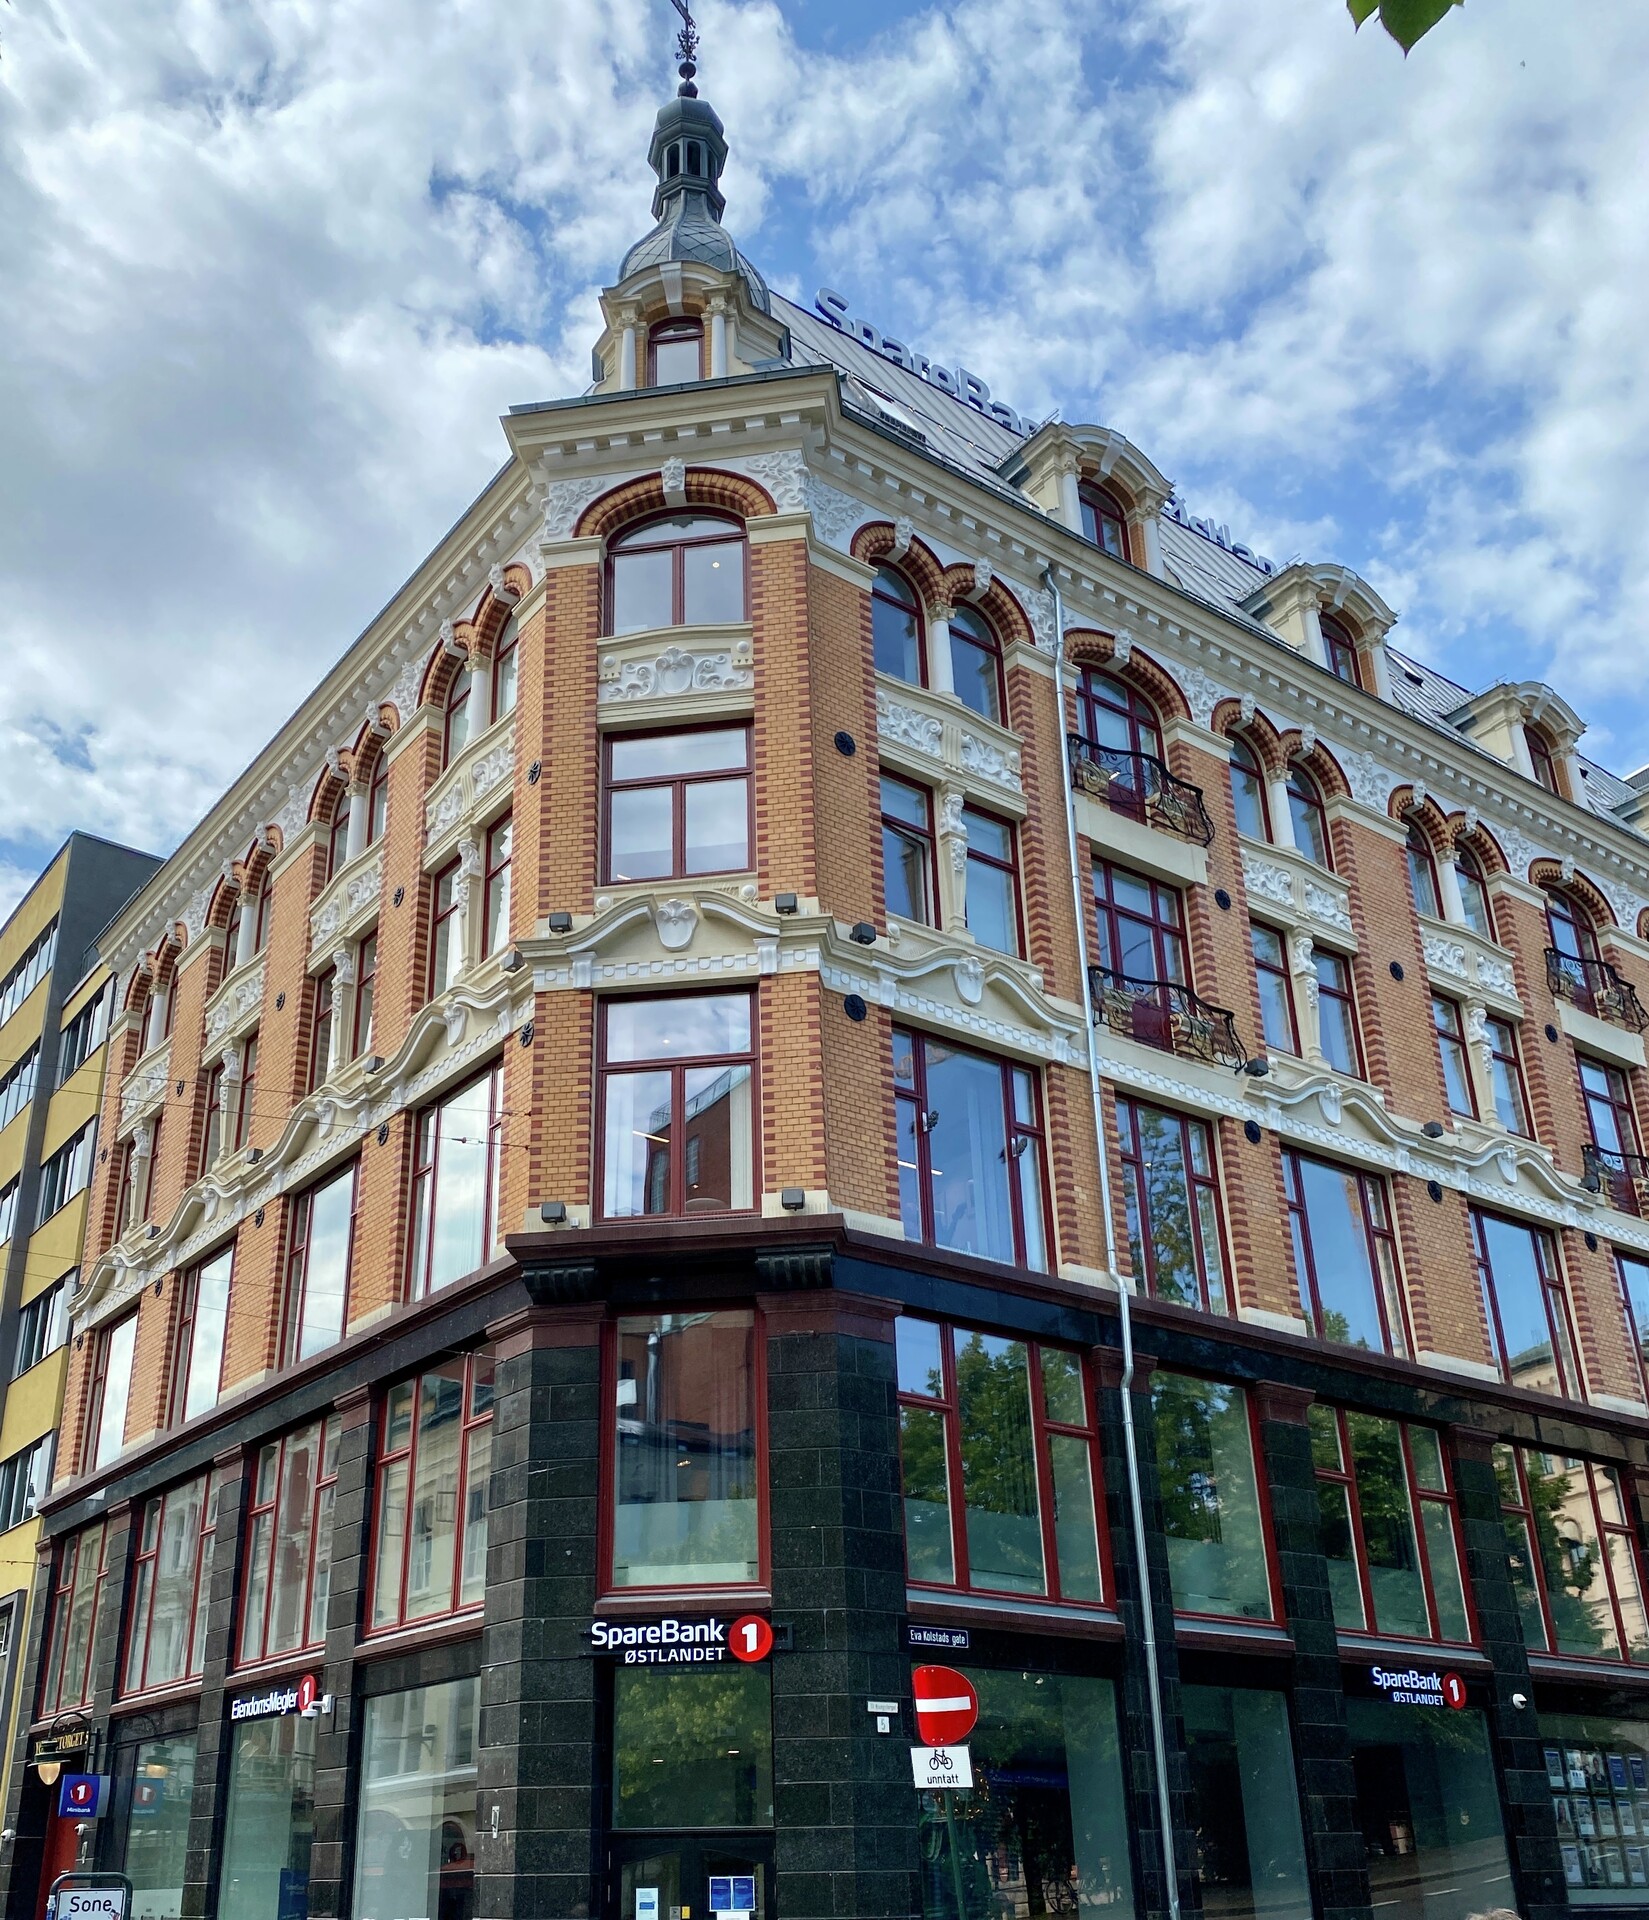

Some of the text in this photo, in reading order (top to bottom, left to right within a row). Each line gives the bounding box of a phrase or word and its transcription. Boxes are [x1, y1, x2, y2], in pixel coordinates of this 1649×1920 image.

[815, 287, 1043, 436] SpareBan
[591, 1618, 757, 1653] SpareBank 1
[910, 1629, 966, 1647] Eva Kolstads gate
[625, 1647, 726, 1664] ØSTLANDET
[1372, 1666, 1460, 1702] SpareBank 1
[231, 1687, 298, 1720] EiendomsMegler
[1393, 1691, 1444, 1706] ØSTLANDET
[926, 1773, 960, 1784] unntatt
[66, 1806, 91, 1814] Minibank
[69, 1896, 113, 1913] Sone
